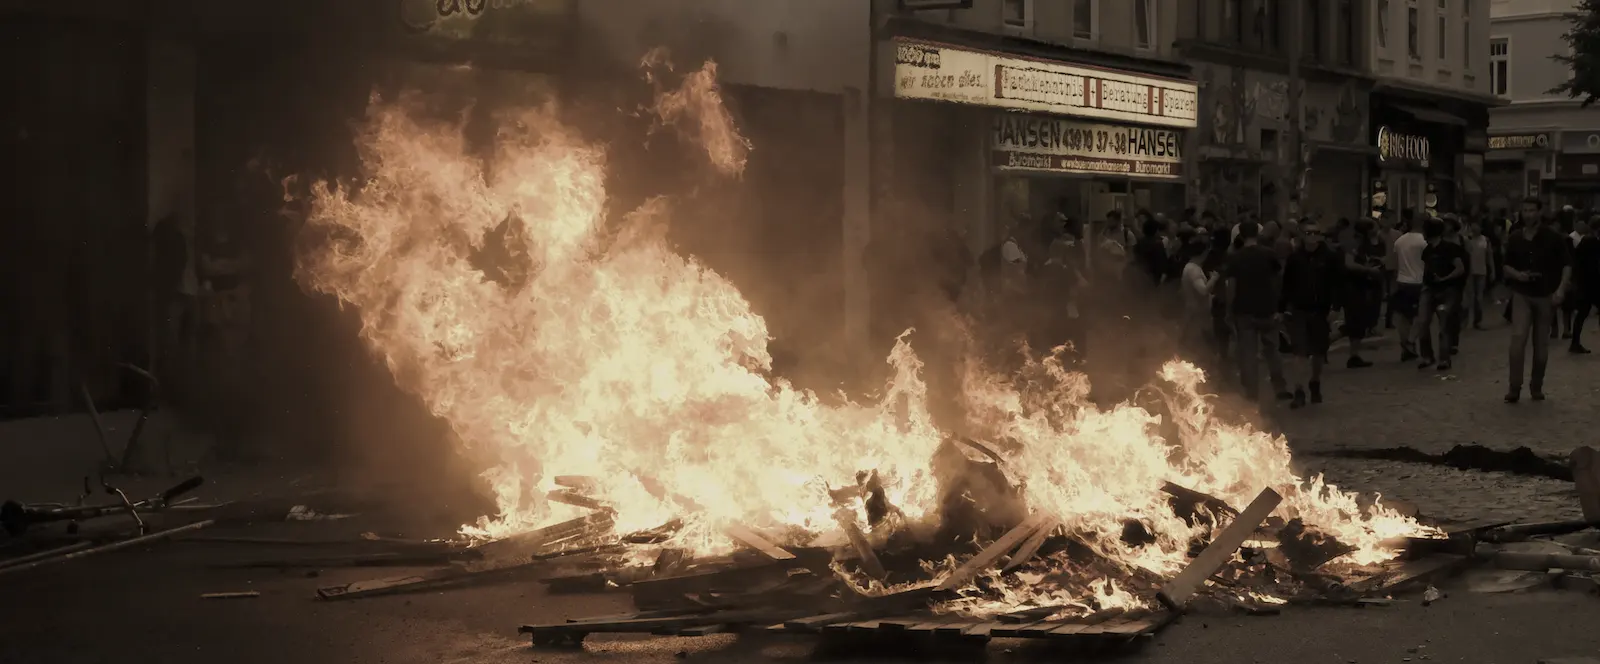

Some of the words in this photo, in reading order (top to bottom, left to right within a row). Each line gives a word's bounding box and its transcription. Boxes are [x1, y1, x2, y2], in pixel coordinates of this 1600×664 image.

[1003, 69, 1083, 97] Fachkenntnis
[1102, 84, 1149, 109] Beratung
[1164, 93, 1195, 112] Sparen
[992, 116, 1060, 150] HANSEN
[1128, 129, 1184, 158] HANSEN
[1390, 132, 1405, 159] BIG
[1406, 133, 1430, 160] FOOD
[1009, 152, 1051, 168] Büromarkt
[1136, 160, 1171, 174] Büromarkt
